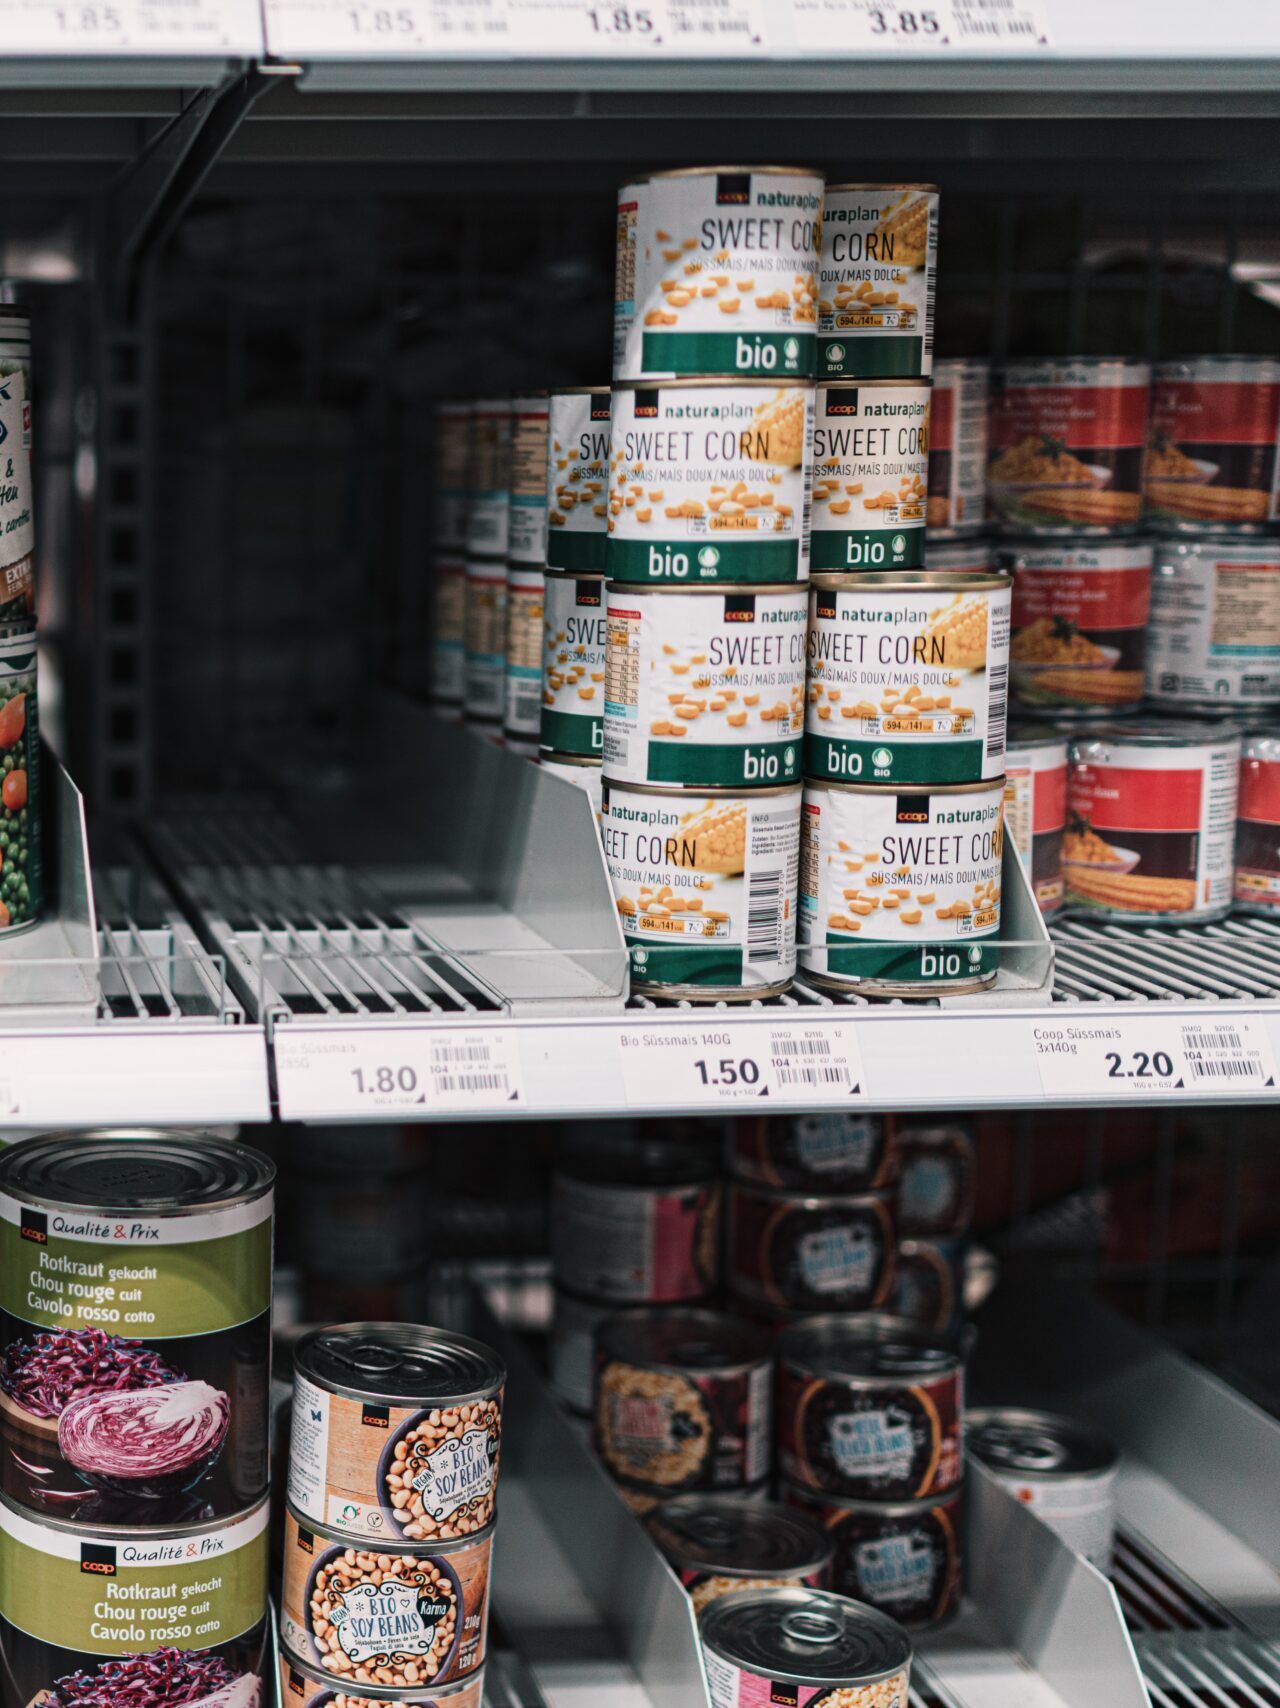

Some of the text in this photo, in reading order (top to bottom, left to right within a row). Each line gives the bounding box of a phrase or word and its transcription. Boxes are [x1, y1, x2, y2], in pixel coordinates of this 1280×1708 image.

[587, 10, 654, 34] 1.85
[869, 10, 940, 35] 3.85
[701, 217, 784, 251] SWEET
[832, 232, 895, 262] CORN
[874, 268, 901, 281] DOLCE
[736, 336, 777, 370] bio
[665, 402, 753, 421] naturaplan
[828, 405, 857, 415] coop
[625, 430, 770, 462] SWEET CORN
[814, 429, 890, 457] SWEET
[649, 545, 689, 578] bio
[847, 536, 885, 564] bio
[700, 568, 718, 578] BIO
[725, 611, 754, 622] coop
[842, 607, 927, 626] naturaplan
[709, 635, 784, 666] SWEET
[810, 630, 946, 665] SWEET CORN
[744, 748, 778, 779] bio
[828, 743, 863, 775] bio
[874, 768, 891, 777] BIO
[611, 806, 679, 827] naturaplan
[752, 814, 769, 823] INFO
[897, 813, 928, 823] coop
[636, 834, 696, 867] CORN
[882, 835, 963, 865] SWEET
[674, 874, 705, 888] DOLCE
[633, 965, 647, 974] BIO
[921, 947, 960, 977] bio
[969, 965, 981, 974] BIO
[620, 1033, 731, 1047] Bio Süssmais 140G
[1033, 1027, 1122, 1041] Coop Süssmais
[1035, 1042, 1078, 1054] 3x140g
[1183, 1052, 1203, 1060] 104
[694, 1059, 760, 1085] 1.50
[771, 1058, 790, 1068] 104
[1105, 1051, 1174, 1078] 2.20
[351, 1066, 417, 1093] 1.80
[52, 1216, 159, 1240] Qualité & Prix
[39, 1251, 158, 1282] Rotkraut gekocht
[30, 1271, 143, 1304] Chou rouge cuit
[27, 1291, 156, 1324] Cavolo rosso cotto
[363, 1415, 387, 1426] coop
[453, 1445, 474, 1470] BIO
[435, 1454, 488, 1497] SOY BEANS
[123, 1537, 224, 1562] Qualité & Prix
[82, 1560, 115, 1574] coop
[106, 1575, 223, 1601] Rotkraut gekocht
[94, 1601, 211, 1623] Chou rouge cuit
[370, 1597, 397, 1616] BIO
[420, 1601, 446, 1616] Karma
[90, 1619, 221, 1642] Cavolo rosso cotto
[350, 1612, 420, 1638] SOY BEANS
[772, 1694, 797, 1705] coop
